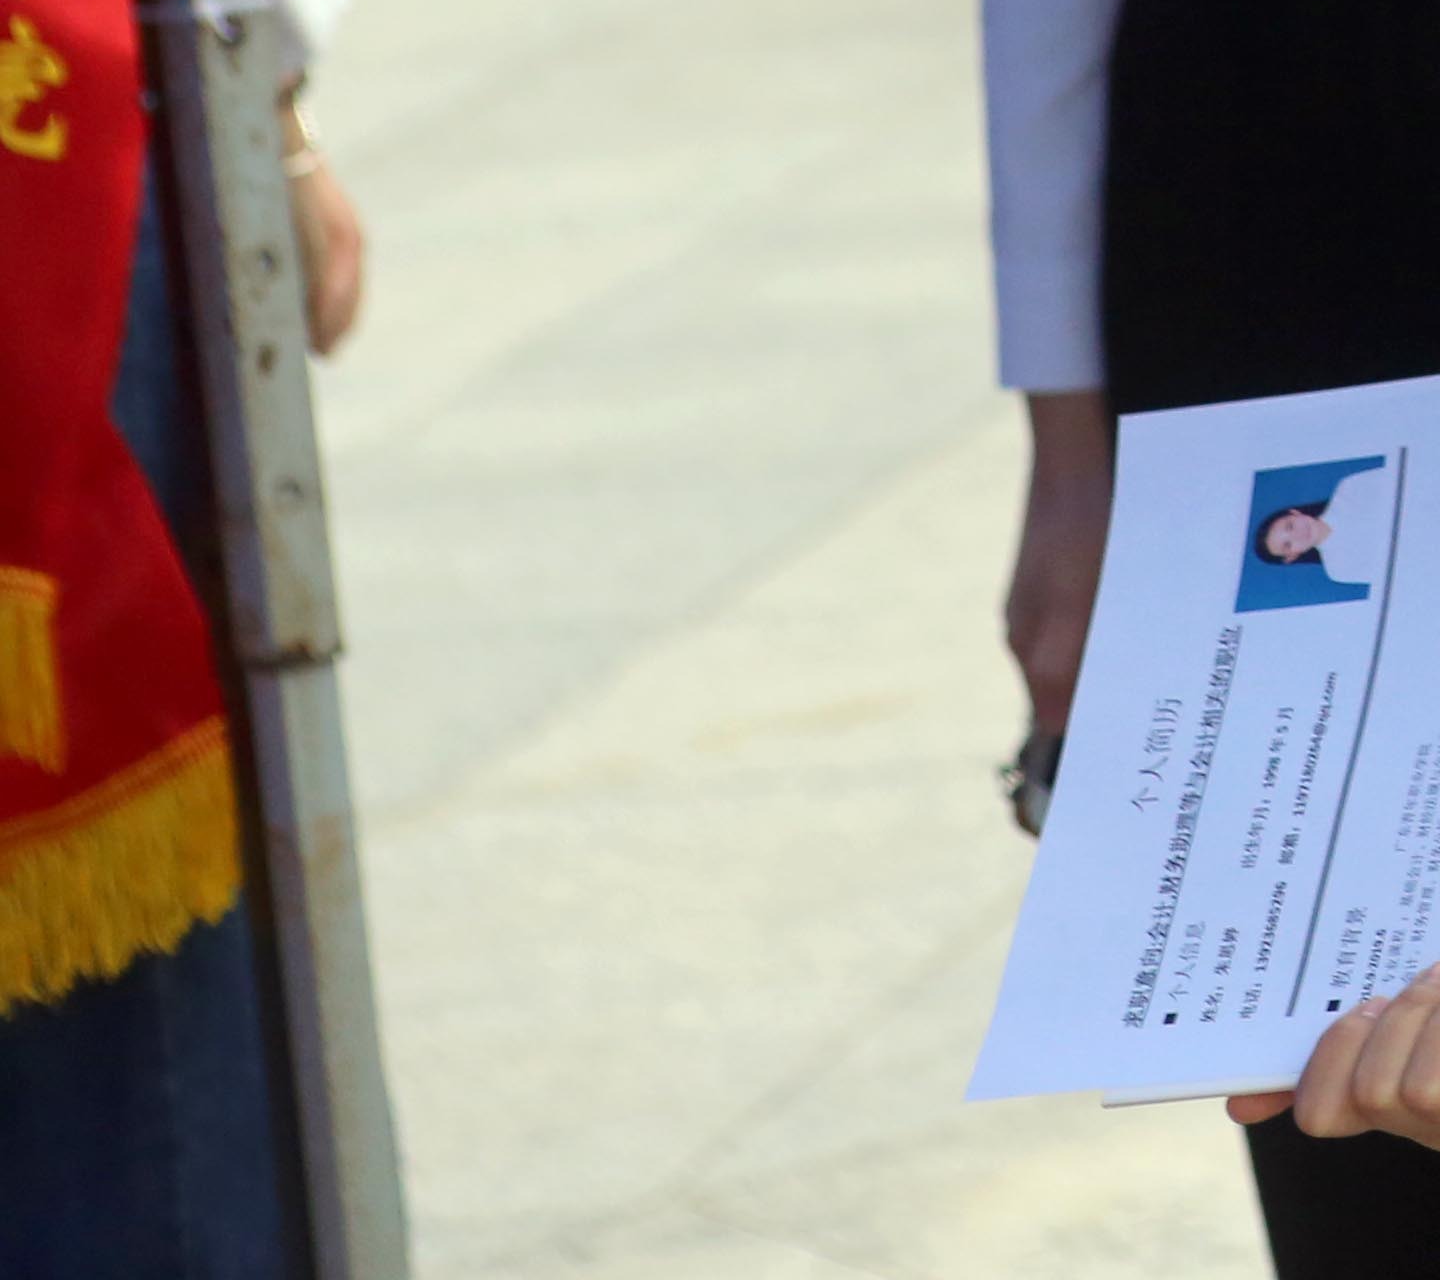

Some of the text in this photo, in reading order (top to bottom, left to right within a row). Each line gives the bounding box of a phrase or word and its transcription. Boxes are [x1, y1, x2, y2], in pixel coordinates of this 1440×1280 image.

[1127, 695, 1185, 814] 个人简历
[1166, 921, 1206, 1000] 个人信息
[1328, 906, 1368, 987] 教育背景
